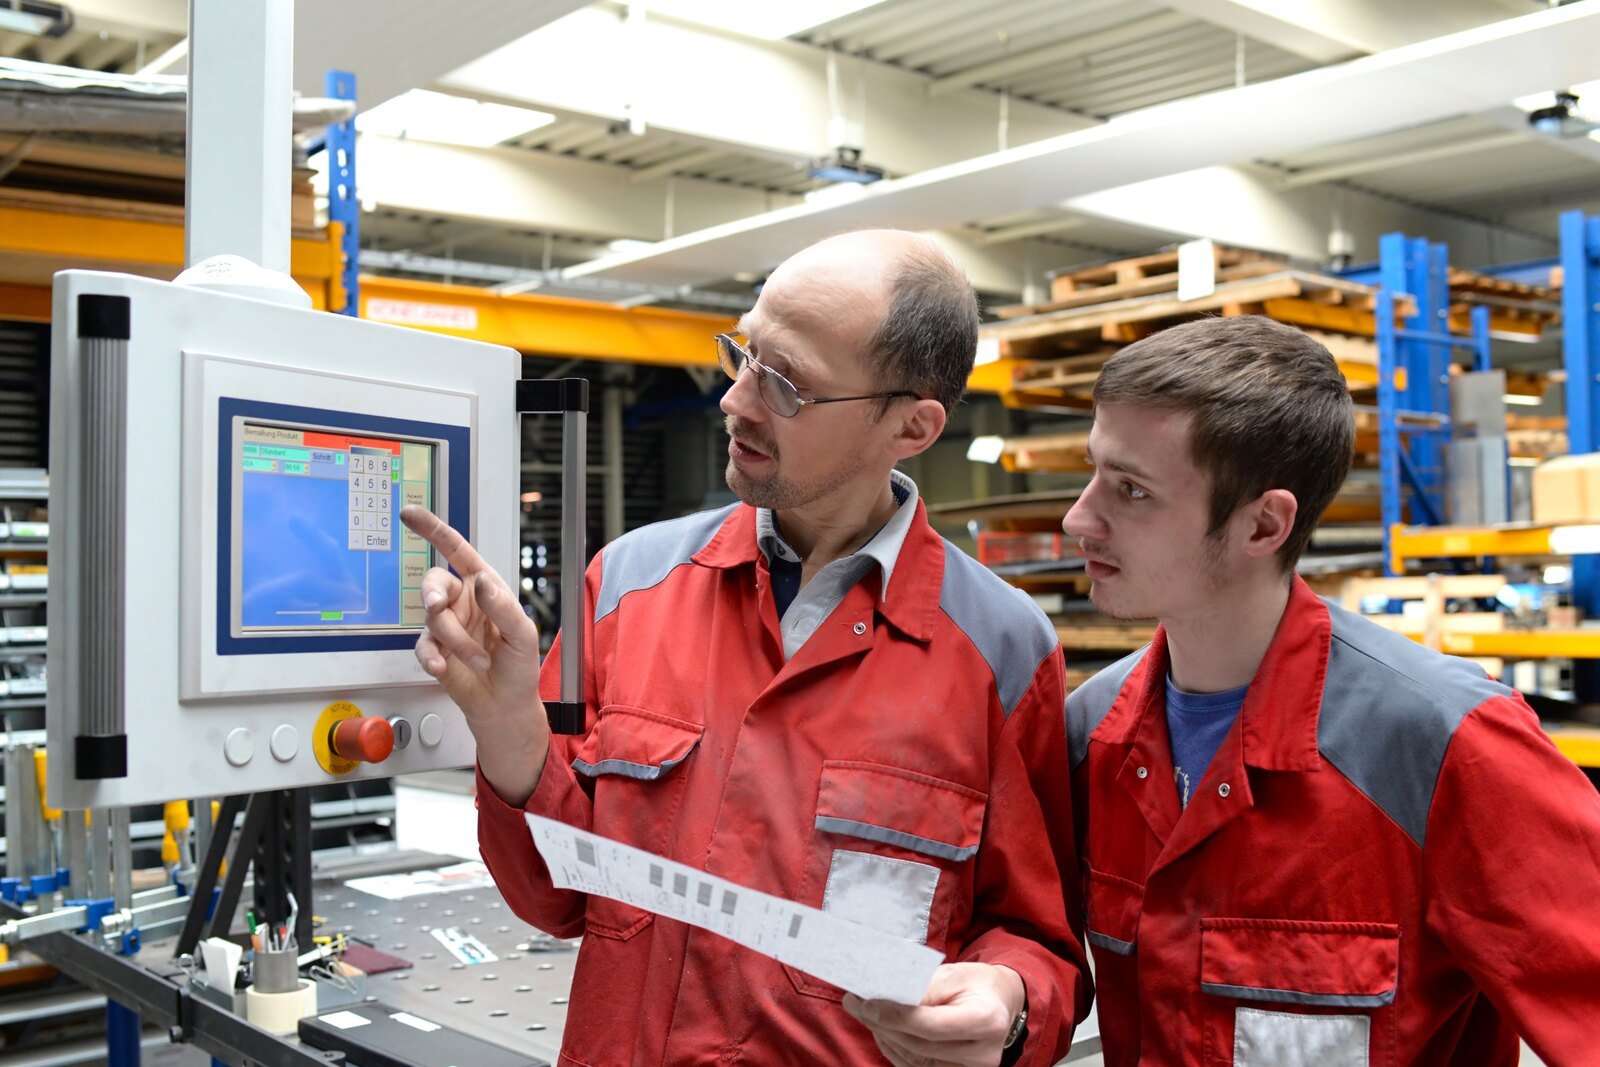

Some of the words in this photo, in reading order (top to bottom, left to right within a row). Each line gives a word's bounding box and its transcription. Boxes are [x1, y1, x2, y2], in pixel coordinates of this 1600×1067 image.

[277, 430, 299, 440] Produkt
[354, 458, 360, 469] 7
[368, 460, 374, 470] 8
[382, 461, 388, 471] 9
[354, 478, 360, 488] 4
[368, 479, 374, 489] 5
[382, 480, 387, 490] 6
[368, 497, 374, 508] 2
[382, 498, 388, 509] 3
[354, 515, 360, 526] 0
[381, 517, 389, 528] C
[366, 535, 389, 546] Enter
